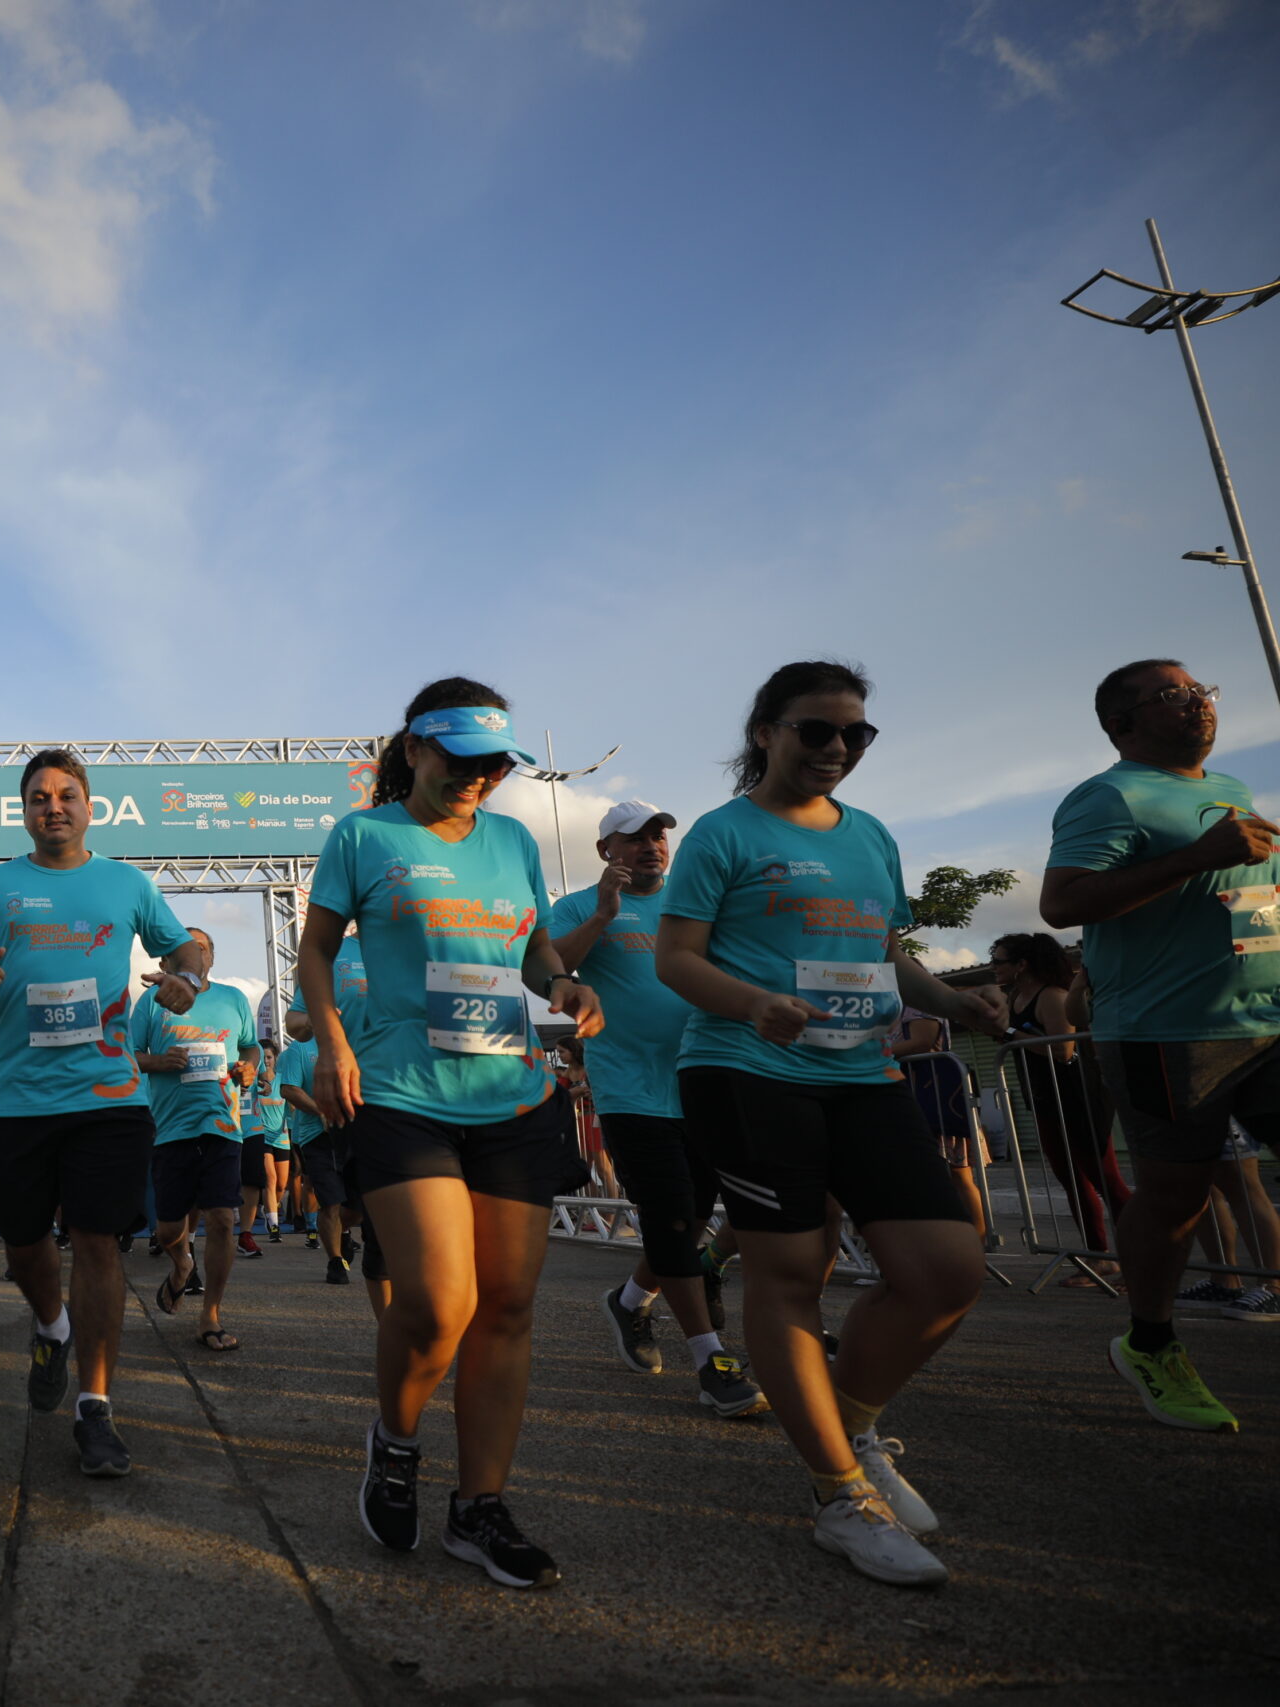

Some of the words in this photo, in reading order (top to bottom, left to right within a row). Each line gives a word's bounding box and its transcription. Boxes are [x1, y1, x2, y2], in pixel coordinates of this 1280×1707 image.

[186, 792, 224, 801] Parceiros
[259, 794, 280, 804] Dia
[283, 794, 299, 804] de
[302, 795, 332, 804] Doar
[411, 871, 455, 879] Brilhantes
[401, 898, 485, 915] CORRIDA
[493, 898, 516, 916] 5k
[778, 897, 856, 913] CORRIDA
[426, 911, 516, 929] SOLIDÁRIA
[44, 1005, 76, 1024] 365
[452, 998, 498, 1021] 226
[826, 995, 874, 1018] 228
[189, 1056, 210, 1067] 367
